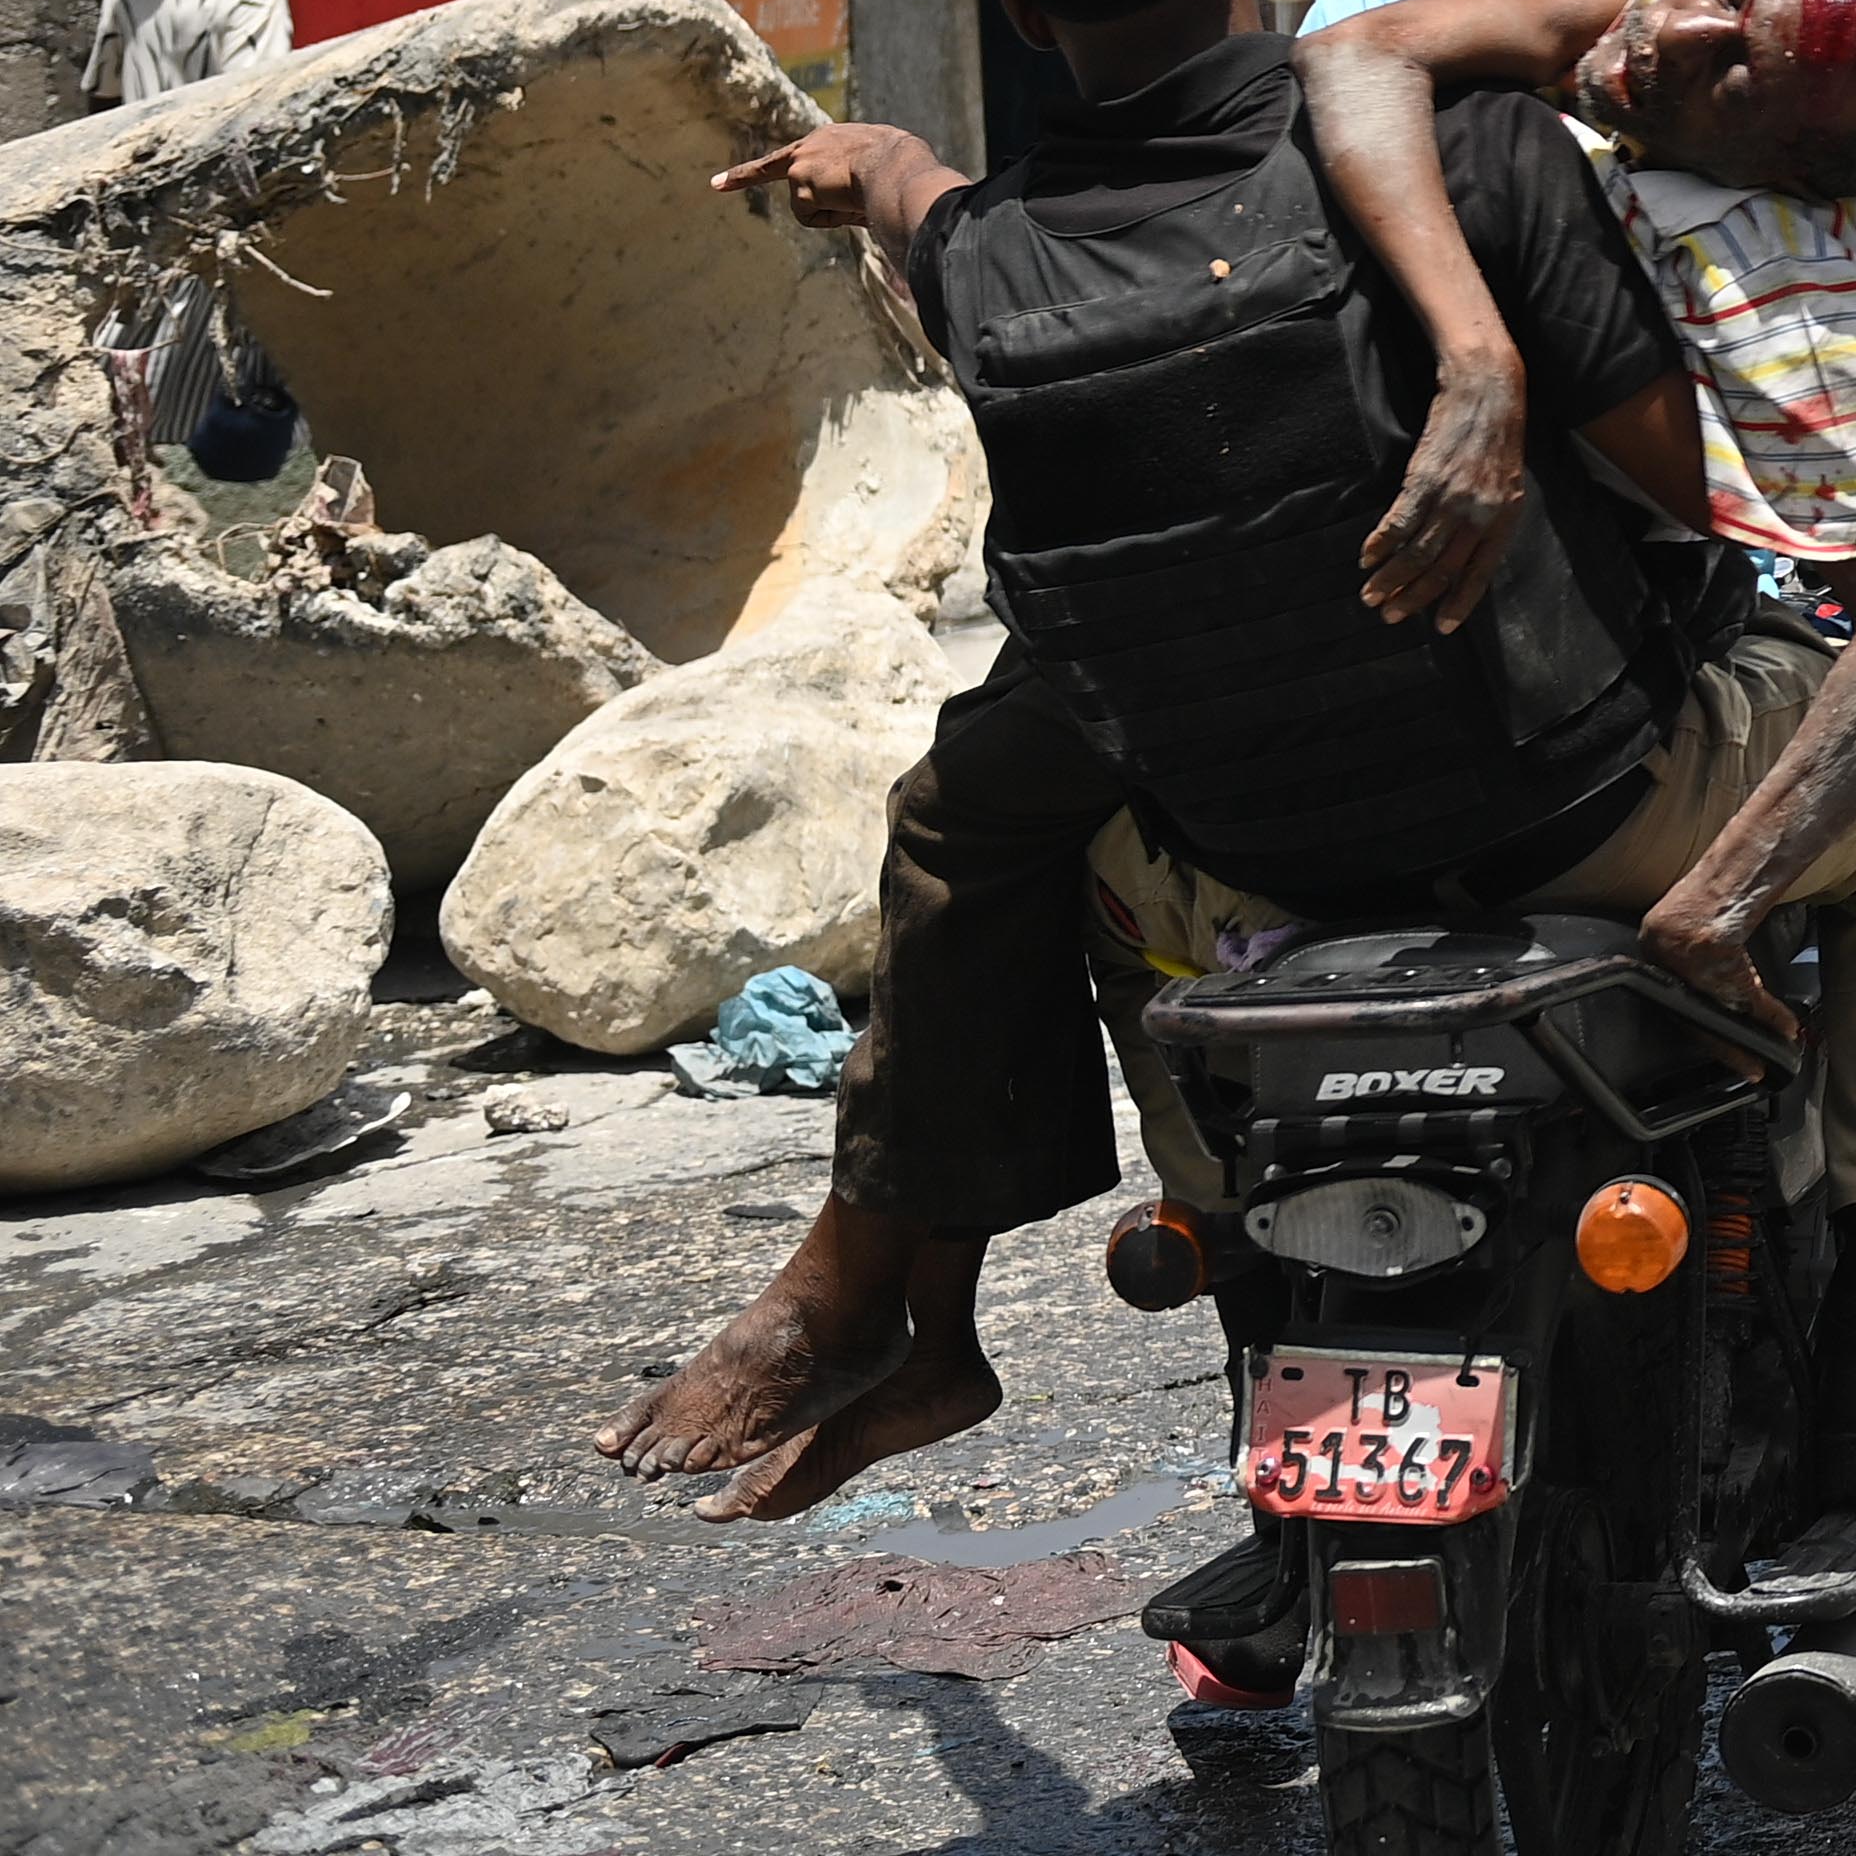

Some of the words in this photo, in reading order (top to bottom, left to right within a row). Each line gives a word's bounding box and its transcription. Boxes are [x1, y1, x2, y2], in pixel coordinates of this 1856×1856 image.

[1315, 1066, 1505, 1101] BOXER
[1255, 1377, 1275, 1461] HAIT
[1343, 1367, 1414, 1428] TB
[1277, 1426, 1476, 1511] 51367
